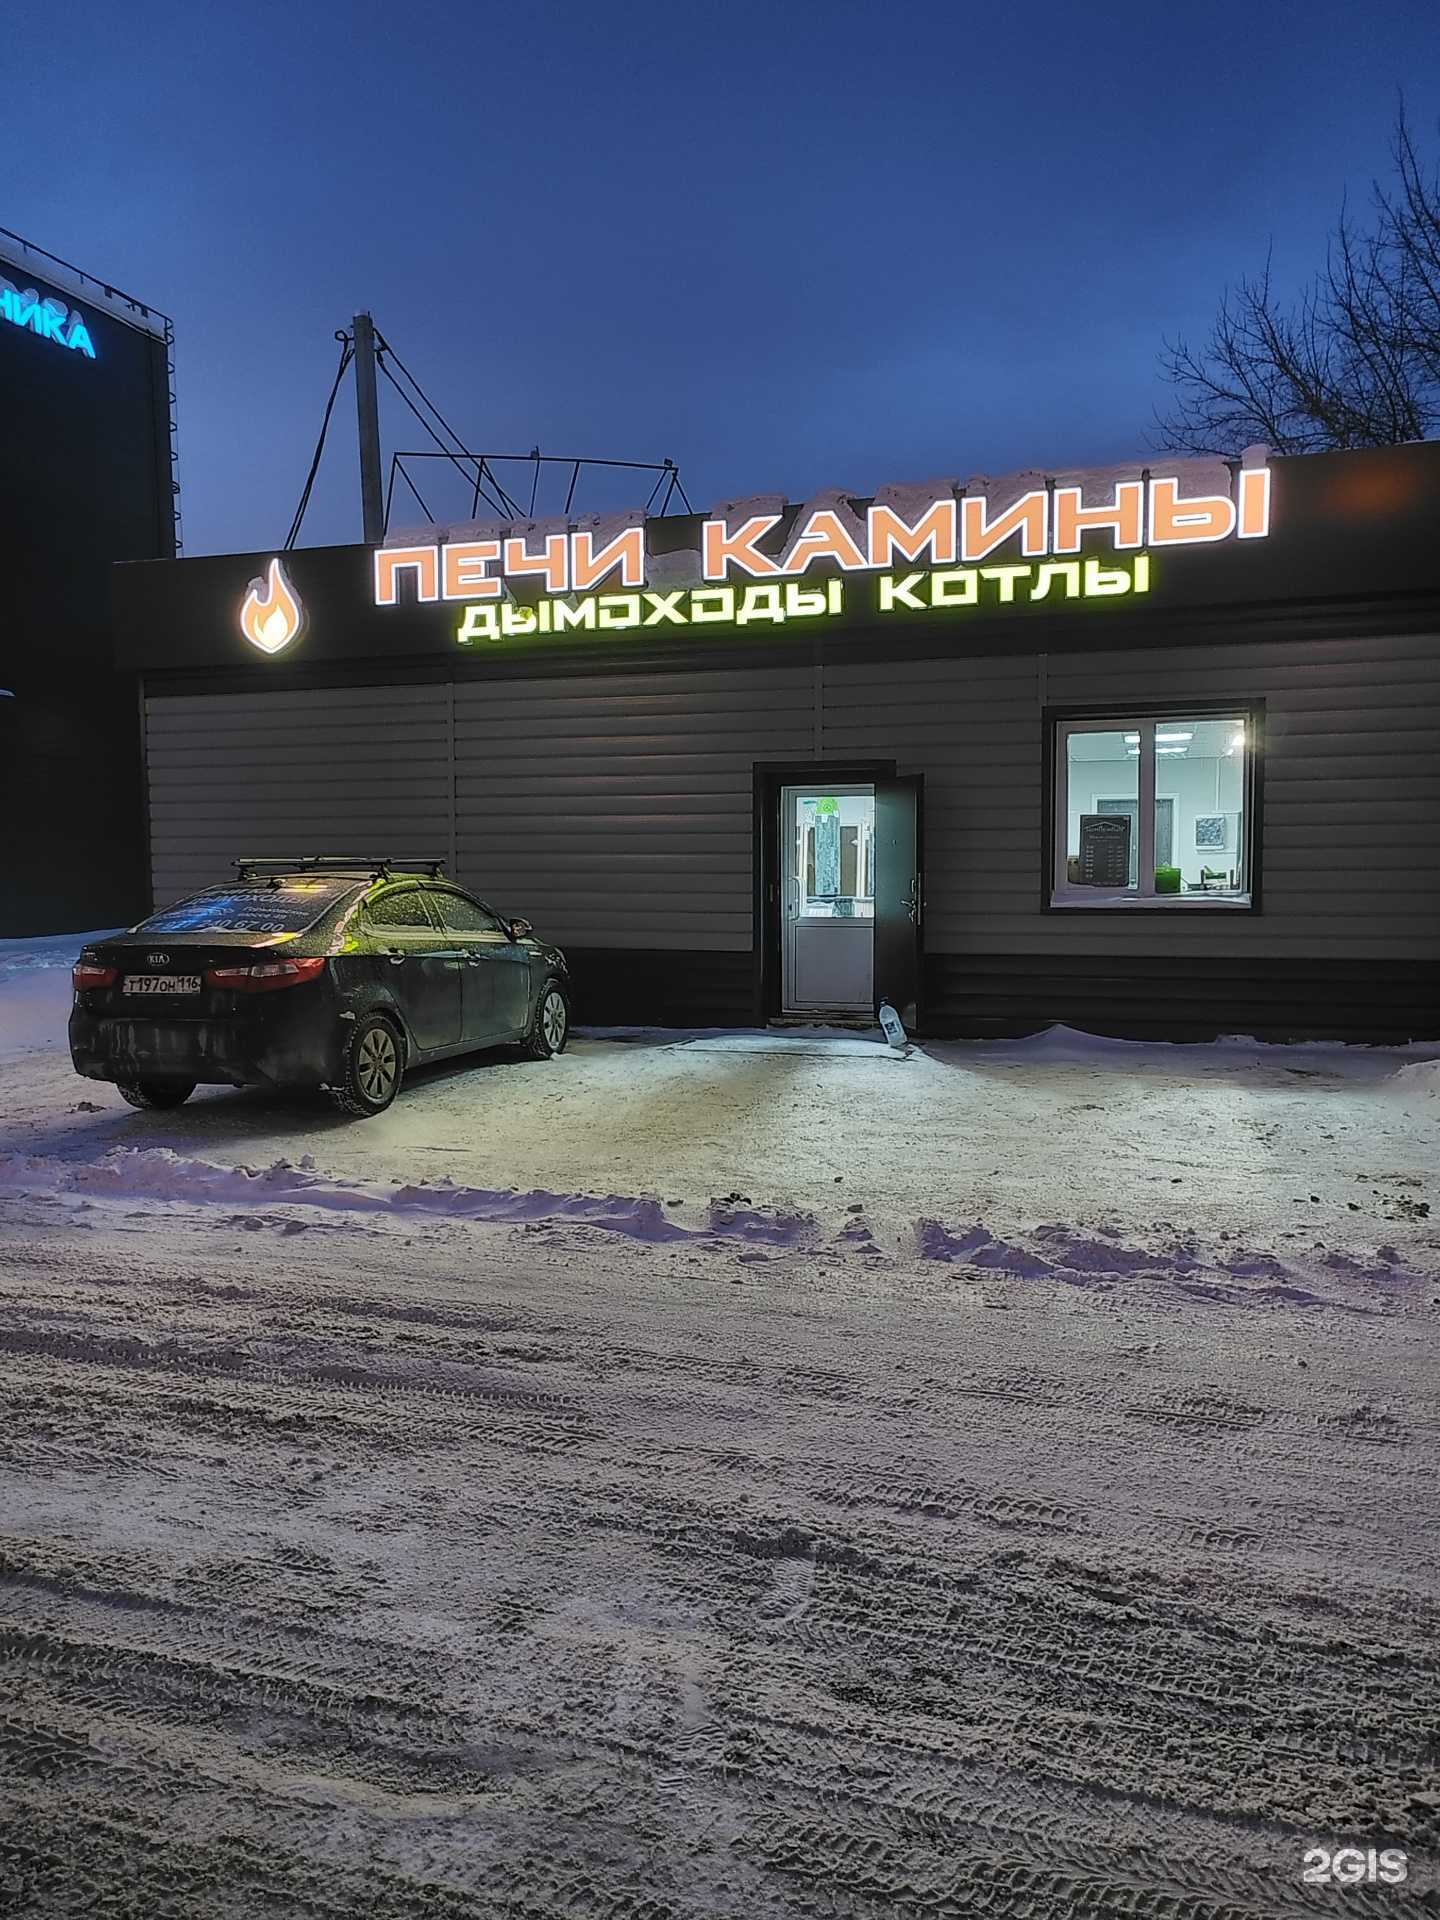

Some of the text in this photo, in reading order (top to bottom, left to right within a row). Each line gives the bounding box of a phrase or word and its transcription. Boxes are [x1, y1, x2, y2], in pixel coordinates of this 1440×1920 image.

[374, 467, 1272, 606] ПЕЧИ КАМИНЫ
[457, 554, 1151, 643] ДЫМОХОДЫ КОТЛЫ
[234, 920, 260, 930] 67
[261, 922, 285, 932] 00
[148, 955, 165, 963] KIA
[178, 976, 197, 989] 116
